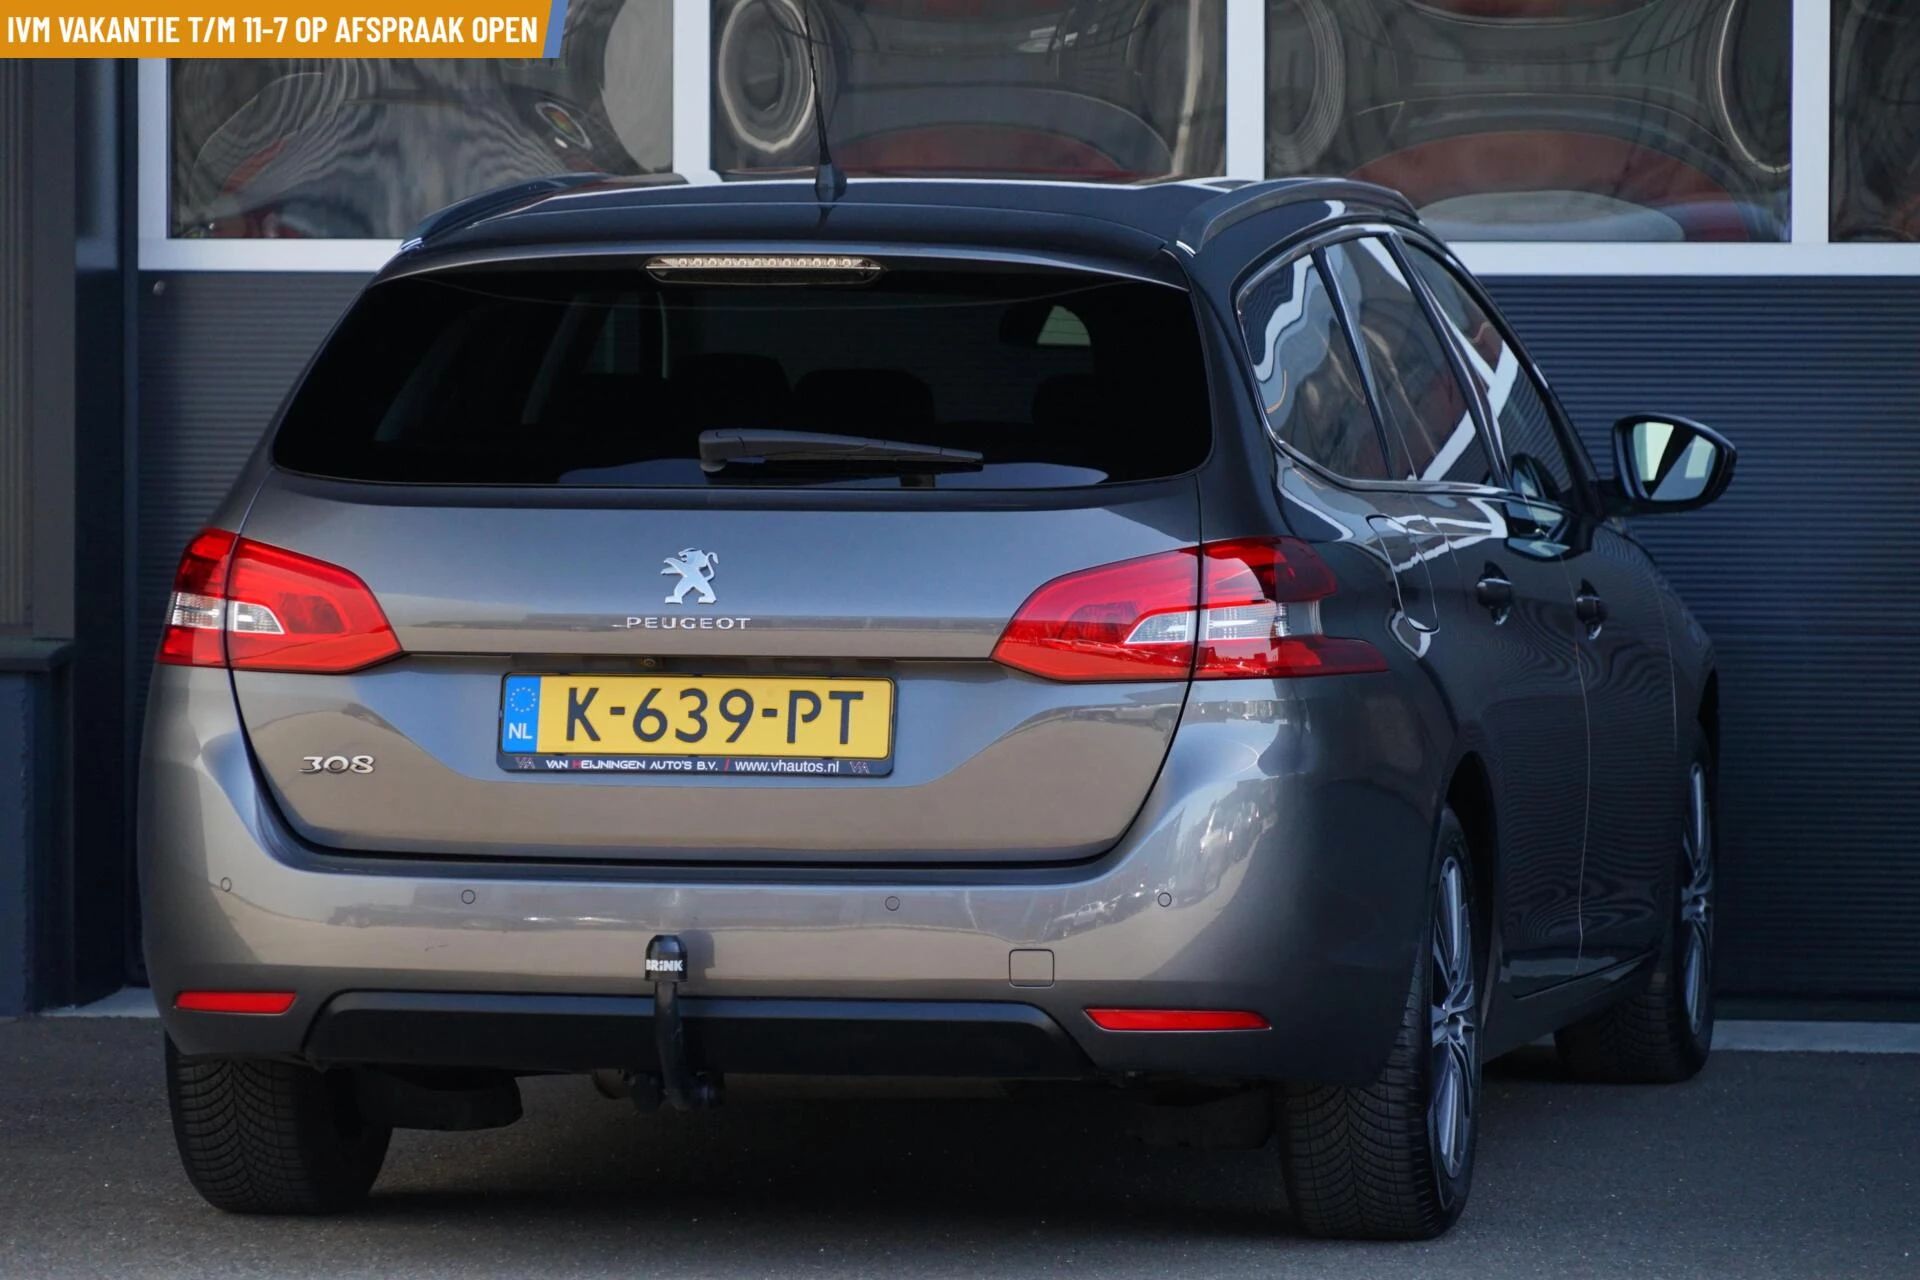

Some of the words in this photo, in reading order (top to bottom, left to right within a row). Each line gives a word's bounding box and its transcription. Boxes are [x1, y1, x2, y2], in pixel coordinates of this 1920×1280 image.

[626, 616, 751, 630] PEUGEOT
[565, 686, 865, 745] K-639-PT
[508, 722, 533, 740] NL
[298, 755, 375, 775] 308
[546, 759, 568, 769] VAN
[572, 760, 645, 770] HEIJNINGEN
[650, 760, 692, 771] AUTO'S
[696, 761, 718, 771] B.V.
[735, 760, 840, 773] www.vhautos.nl
